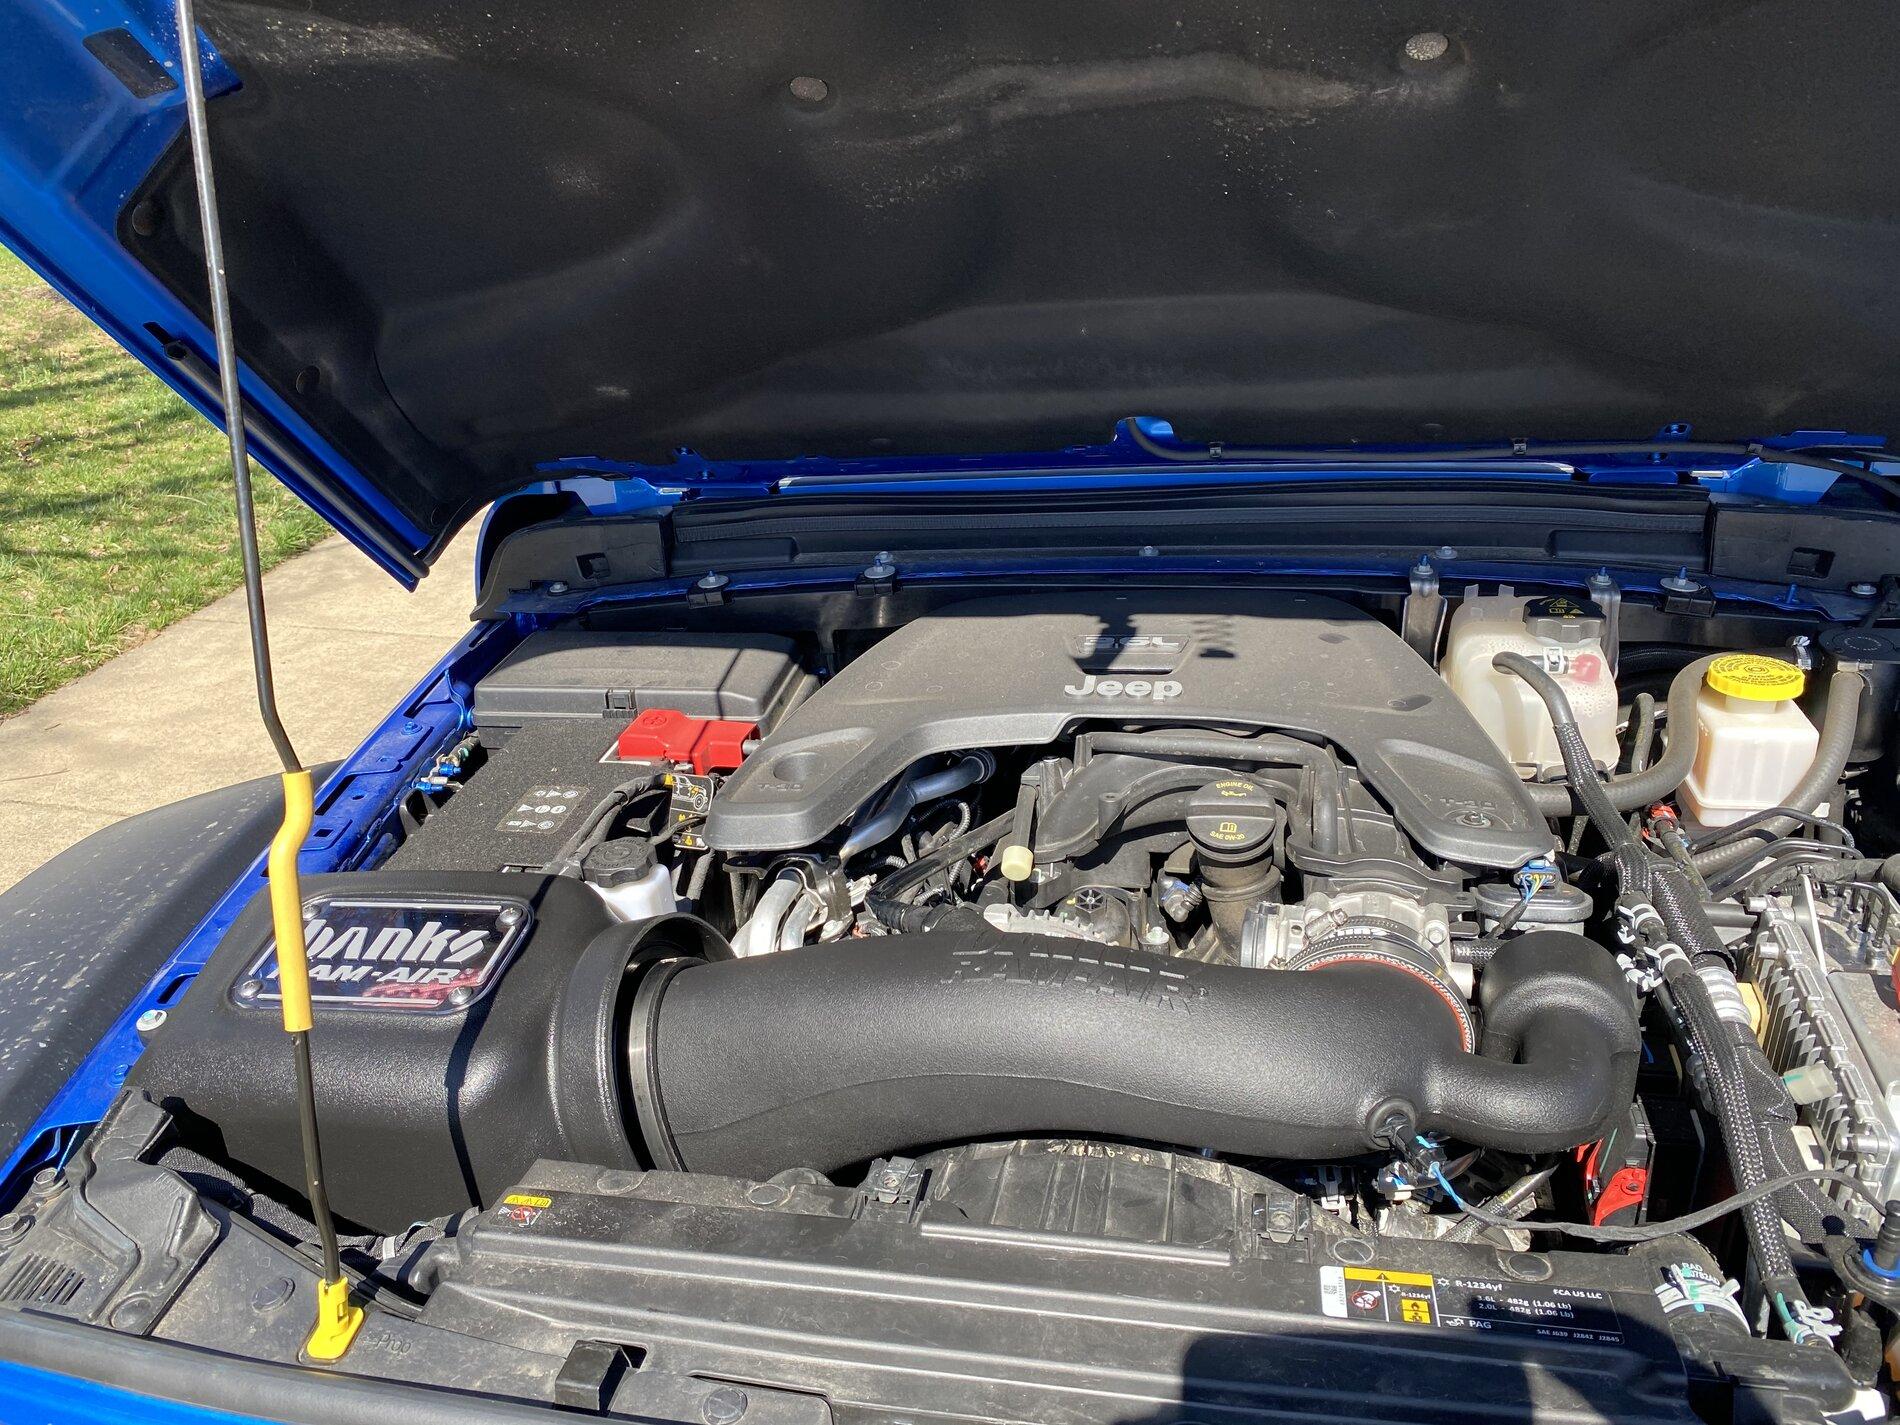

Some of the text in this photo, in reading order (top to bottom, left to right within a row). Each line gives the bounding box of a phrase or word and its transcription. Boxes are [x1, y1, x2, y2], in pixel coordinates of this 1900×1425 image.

[1064, 675, 1183, 701] Jeep
[1215, 781, 1242, 789] ENGINE
[1209, 830, 1224, 839] SAE
[267, 964, 461, 985] AM-AIR
[1455, 1279, 1503, 1291] R-1234yf
[1553, 1288, 1571, 1297] FCA
[1507, 1297, 1530, 1307] 482g
[1532, 1299, 1556, 1309] (1.06
[1479, 1303, 1498, 1311] 2.0L
[1509, 1306, 1532, 1315] 482g
[1534, 1307, 1559, 1317] (1.06
[1469, 1319, 1492, 1329] PAG
